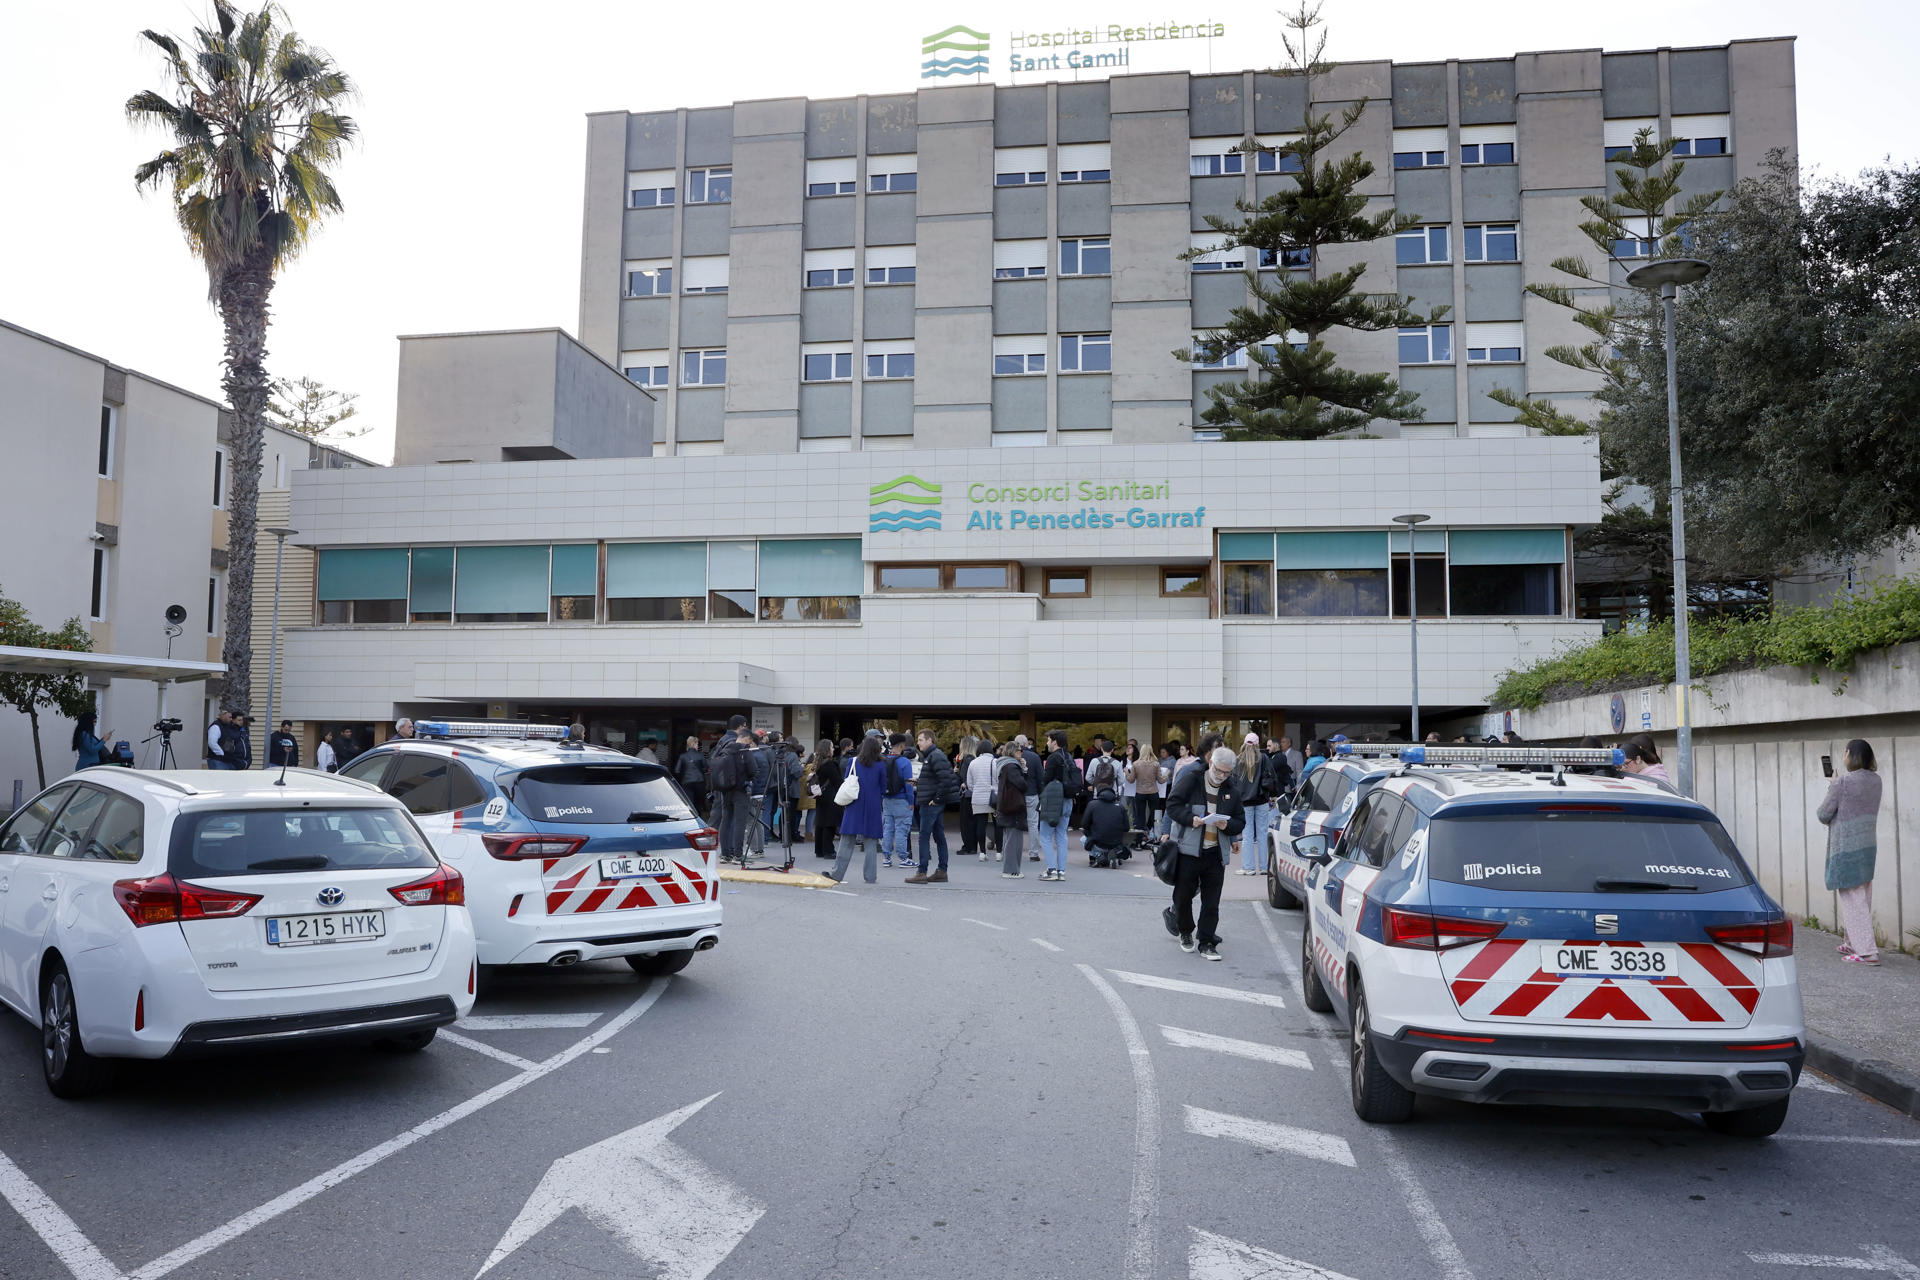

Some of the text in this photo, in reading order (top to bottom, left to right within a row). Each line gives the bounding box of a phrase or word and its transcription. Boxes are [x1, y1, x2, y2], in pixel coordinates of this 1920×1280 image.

[1010, 20, 1225, 49] Hospital Residència
[1009, 47, 1129, 72] Sant Camil
[967, 479, 1170, 503] Consorci Sanitari
[966, 506, 1206, 531] Alt Penedès-Garraf
[488, 804, 503, 816] 112
[558, 805, 593, 817] policia
[1406, 838, 1420, 854] 112
[611, 858, 665, 874] CME 4020
[1484, 862, 1542, 879] policia
[1645, 864, 1731, 879] mossos.cat
[285, 914, 379, 939] 1215 HYK
[207, 961, 238, 970] TOYOTA
[1557, 949, 1666, 973] CME 3638
